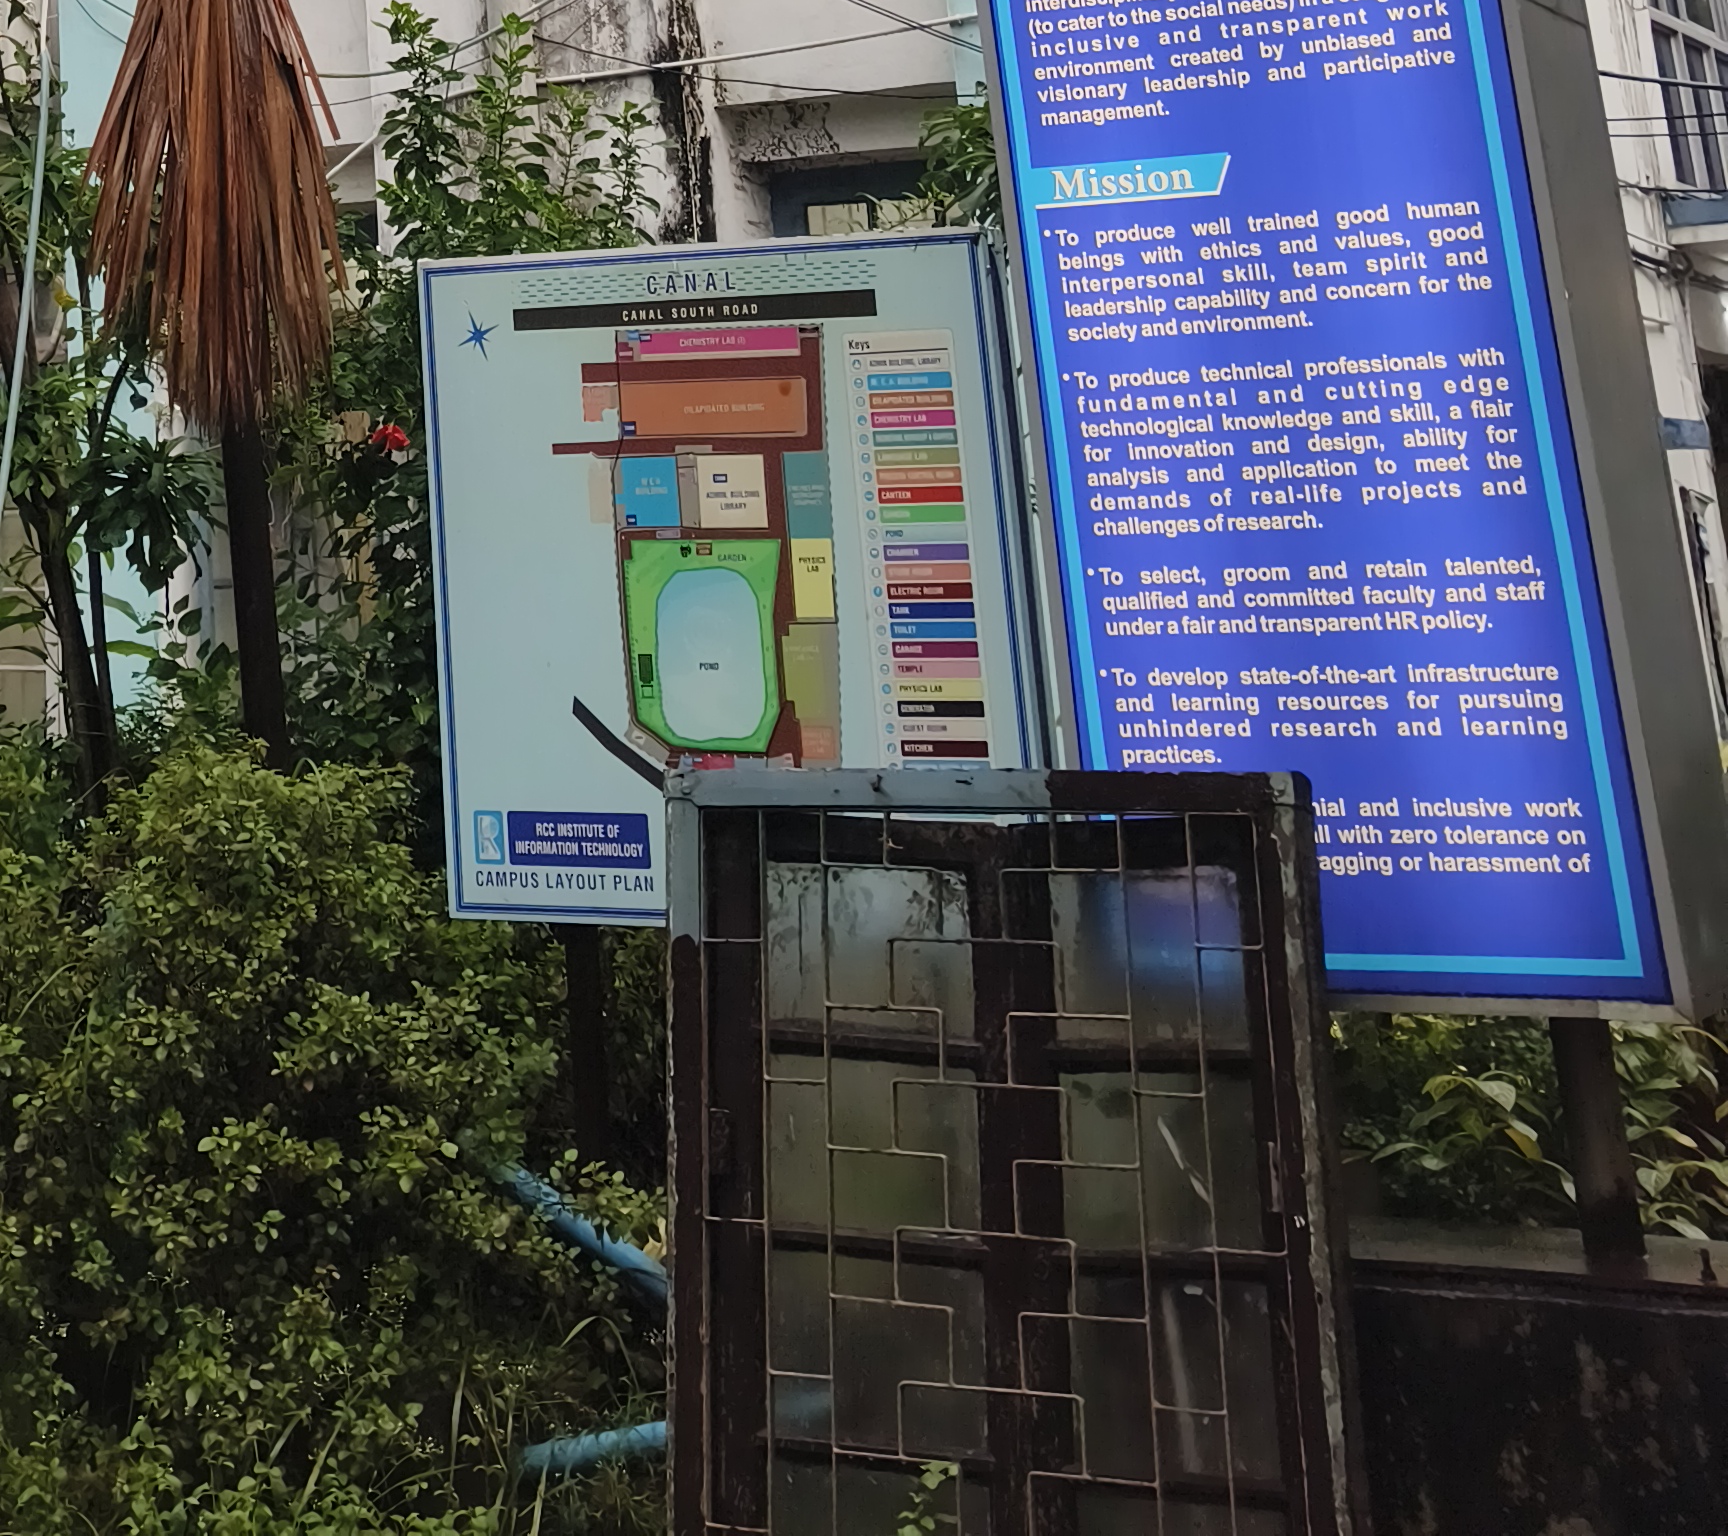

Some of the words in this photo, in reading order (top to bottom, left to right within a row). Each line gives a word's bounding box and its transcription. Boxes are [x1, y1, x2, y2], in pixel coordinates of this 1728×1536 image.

[1031, 33, 1140, 58] inclusive
[1158, 24, 1201, 46] and
[1219, 7, 1368, 39] transparent
[1386, 0, 1449, 22] work
[1037, 82, 1128, 103] visionary
[1143, 67, 1251, 94] leadership
[1267, 61, 1307, 82] and
[1323, 48, 1456, 81] participative
[1041, 99, 1170, 126] management.
[1051, 164, 1194, 200] Mission
[1054, 228, 1080, 247] To
[1095, 223, 1176, 249] produce
[1190, 216, 1232, 237] well
[1247, 209, 1320, 233] trained
[1336, 204, 1390, 230] good
[1406, 200, 1481, 221] human
[646, 271, 736, 295] CANAL
[1061, 266, 1205, 295] interpersonal
[1221, 262, 1276, 283] skill,
[1292, 260, 1348, 278] team
[1365, 251, 1428, 276] spirit
[1445, 246, 1489, 267] and
[622, 309, 663, 322] CANAL
[672, 306, 715, 319] SOUTH
[723, 304, 758, 316] ROAD
[1067, 321, 1138, 343] society
[1141, 317, 1179, 337] and
[1180, 310, 1314, 335] environment.
[848, 339, 870, 351] Keys
[1073, 371, 1099, 390] To
[1108, 367, 1191, 392] produce
[1200, 359, 1294, 383] technical
[1304, 350, 1448, 381] professionals
[1458, 346, 1505, 368] with
[1080, 413, 1214, 439] technological
[1221, 408, 1333, 432] knowledge
[1341, 404, 1382, 425] and
[1389, 402, 1441, 424] skill,
[1449, 405, 1463, 420] a
[1470, 398, 1514, 419] flair
[1087, 465, 1170, 490] analysis
[1186, 462, 1225, 483] and
[1241, 458, 1358, 484] application
[1374, 456, 1397, 475] to
[1415, 453, 1471, 473] meet
[1486, 450, 1523, 470] the
[1093, 516, 1201, 538] challenges
[1203, 513, 1225, 533] of
[1227, 510, 1323, 531] research.
[1097, 567, 1124, 586] To
[1140, 565, 1207, 587] select,
[1223, 566, 1291, 587] groom
[1308, 560, 1348, 580] and
[1365, 558, 1428, 579] retain
[1444, 555, 1541, 577] talented,
[1102, 590, 1189, 615] qualified
[1197, 588, 1236, 609] and
[1243, 586, 1355, 608] committed
[1362, 584, 1436, 609] faculty
[1445, 582, 1487, 603] and
[1495, 580, 1545, 602] staff
[1110, 667, 1137, 687] To
[1147, 666, 1229, 689] develop
[1239, 665, 1398, 686] state-of-the-art
[1407, 663, 1559, 683] infrastructure
[1118, 718, 1252, 738] unhindered
[1270, 717, 1377, 737] research
[1397, 716, 1442, 736] and
[1461, 715, 1568, 740] learning
[1122, 744, 1223, 769] practices.
[1359, 797, 1400, 817] and
[1412, 797, 1513, 818] inclusive
[1524, 797, 1583, 818] work
[535, 822, 556, 837] RCC
[557, 823, 605, 838] INSTITUTE
[606, 824, 620, 839] OF
[1337, 824, 1384, 844] with
[1389, 829, 1438, 845] zero
[1443, 824, 1549, 845] tolerance
[1556, 829, 1586, 846] on
[515, 840, 579, 856] INFORMATION
[581, 842, 644, 858] TECHNOLOGY
[1317, 851, 1393, 876] agging
[1399, 856, 1423, 871] or
[1428, 851, 1563, 873] harassment
[1567, 852, 1591, 873] of
[475, 870, 539, 889] CAMPUS
[546, 872, 607, 891] LAYOUT
[613, 874, 654, 892] PLAN
